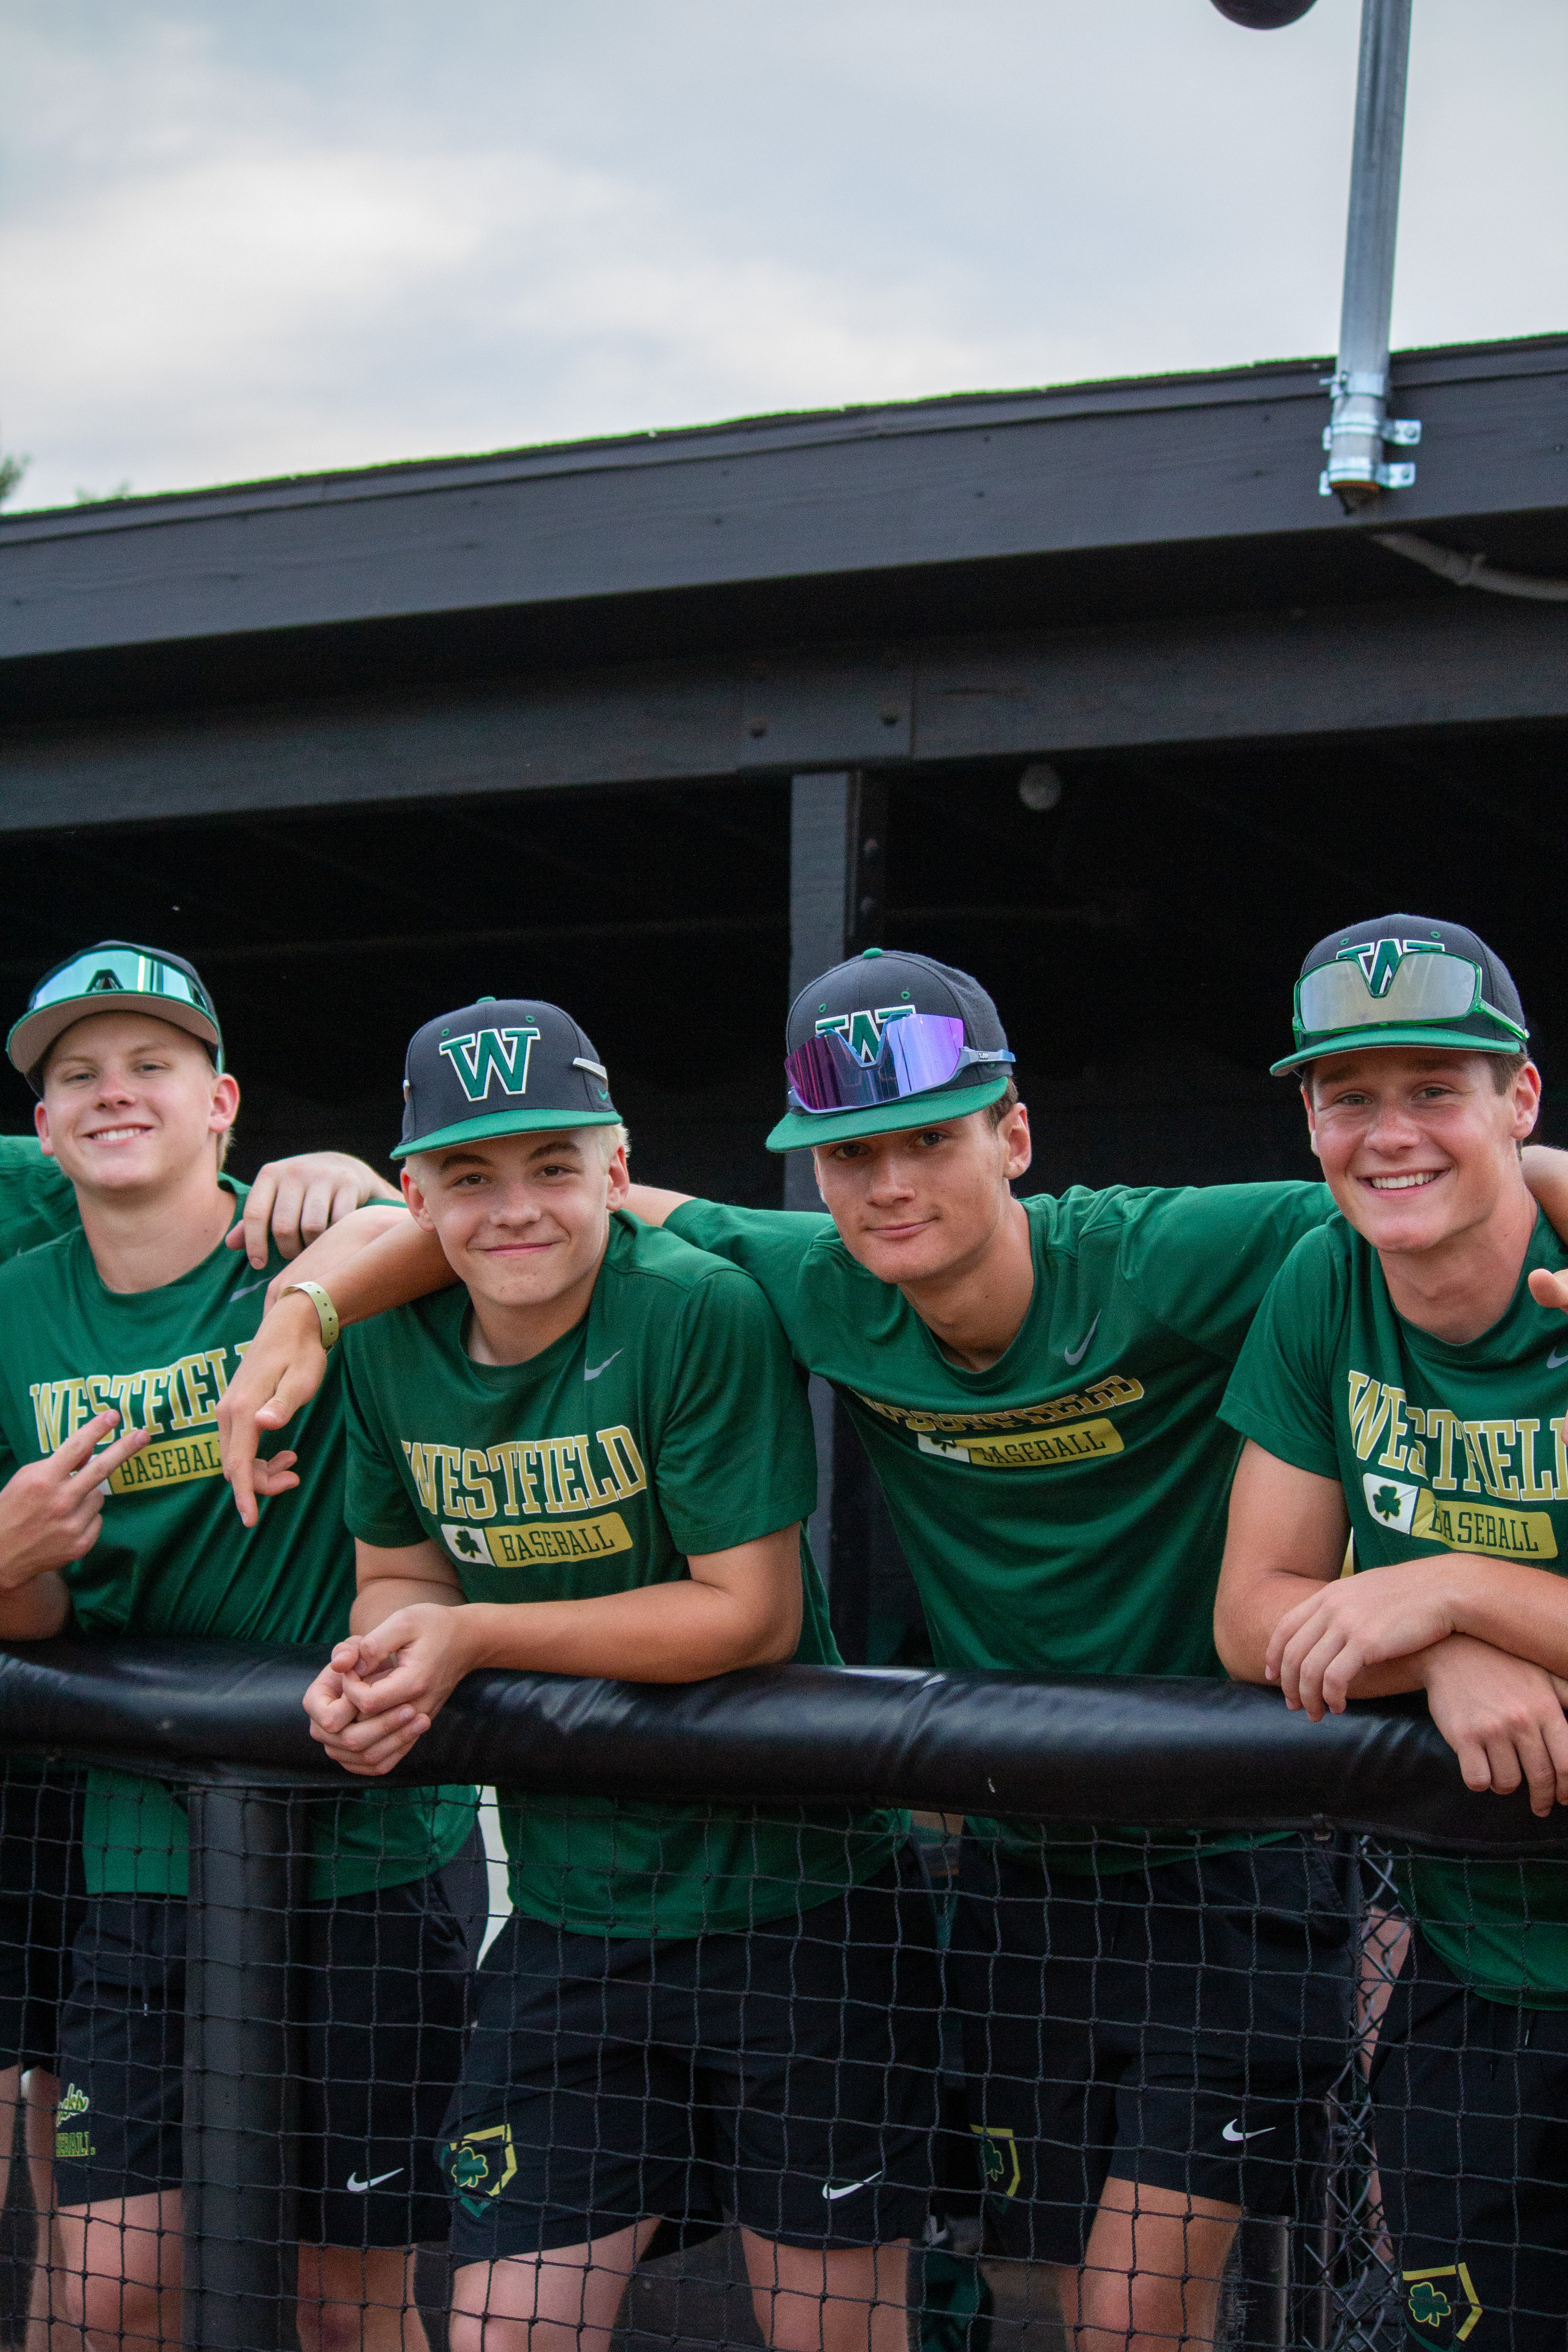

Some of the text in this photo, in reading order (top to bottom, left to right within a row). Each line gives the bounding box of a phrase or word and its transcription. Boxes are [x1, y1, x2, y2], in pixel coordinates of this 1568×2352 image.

[439, 1027, 540, 1102] W
[29, 1340, 252, 1454] WESTFIEL
[120, 1440, 222, 1486] BASEBAL
[971, 1431, 1106, 1463] BASEBALL
[401, 1425, 647, 1520] WESTFIELD
[499, 1525, 615, 1562] BASEBALL
[1429, 1510, 1539, 1552] BASEBALL
